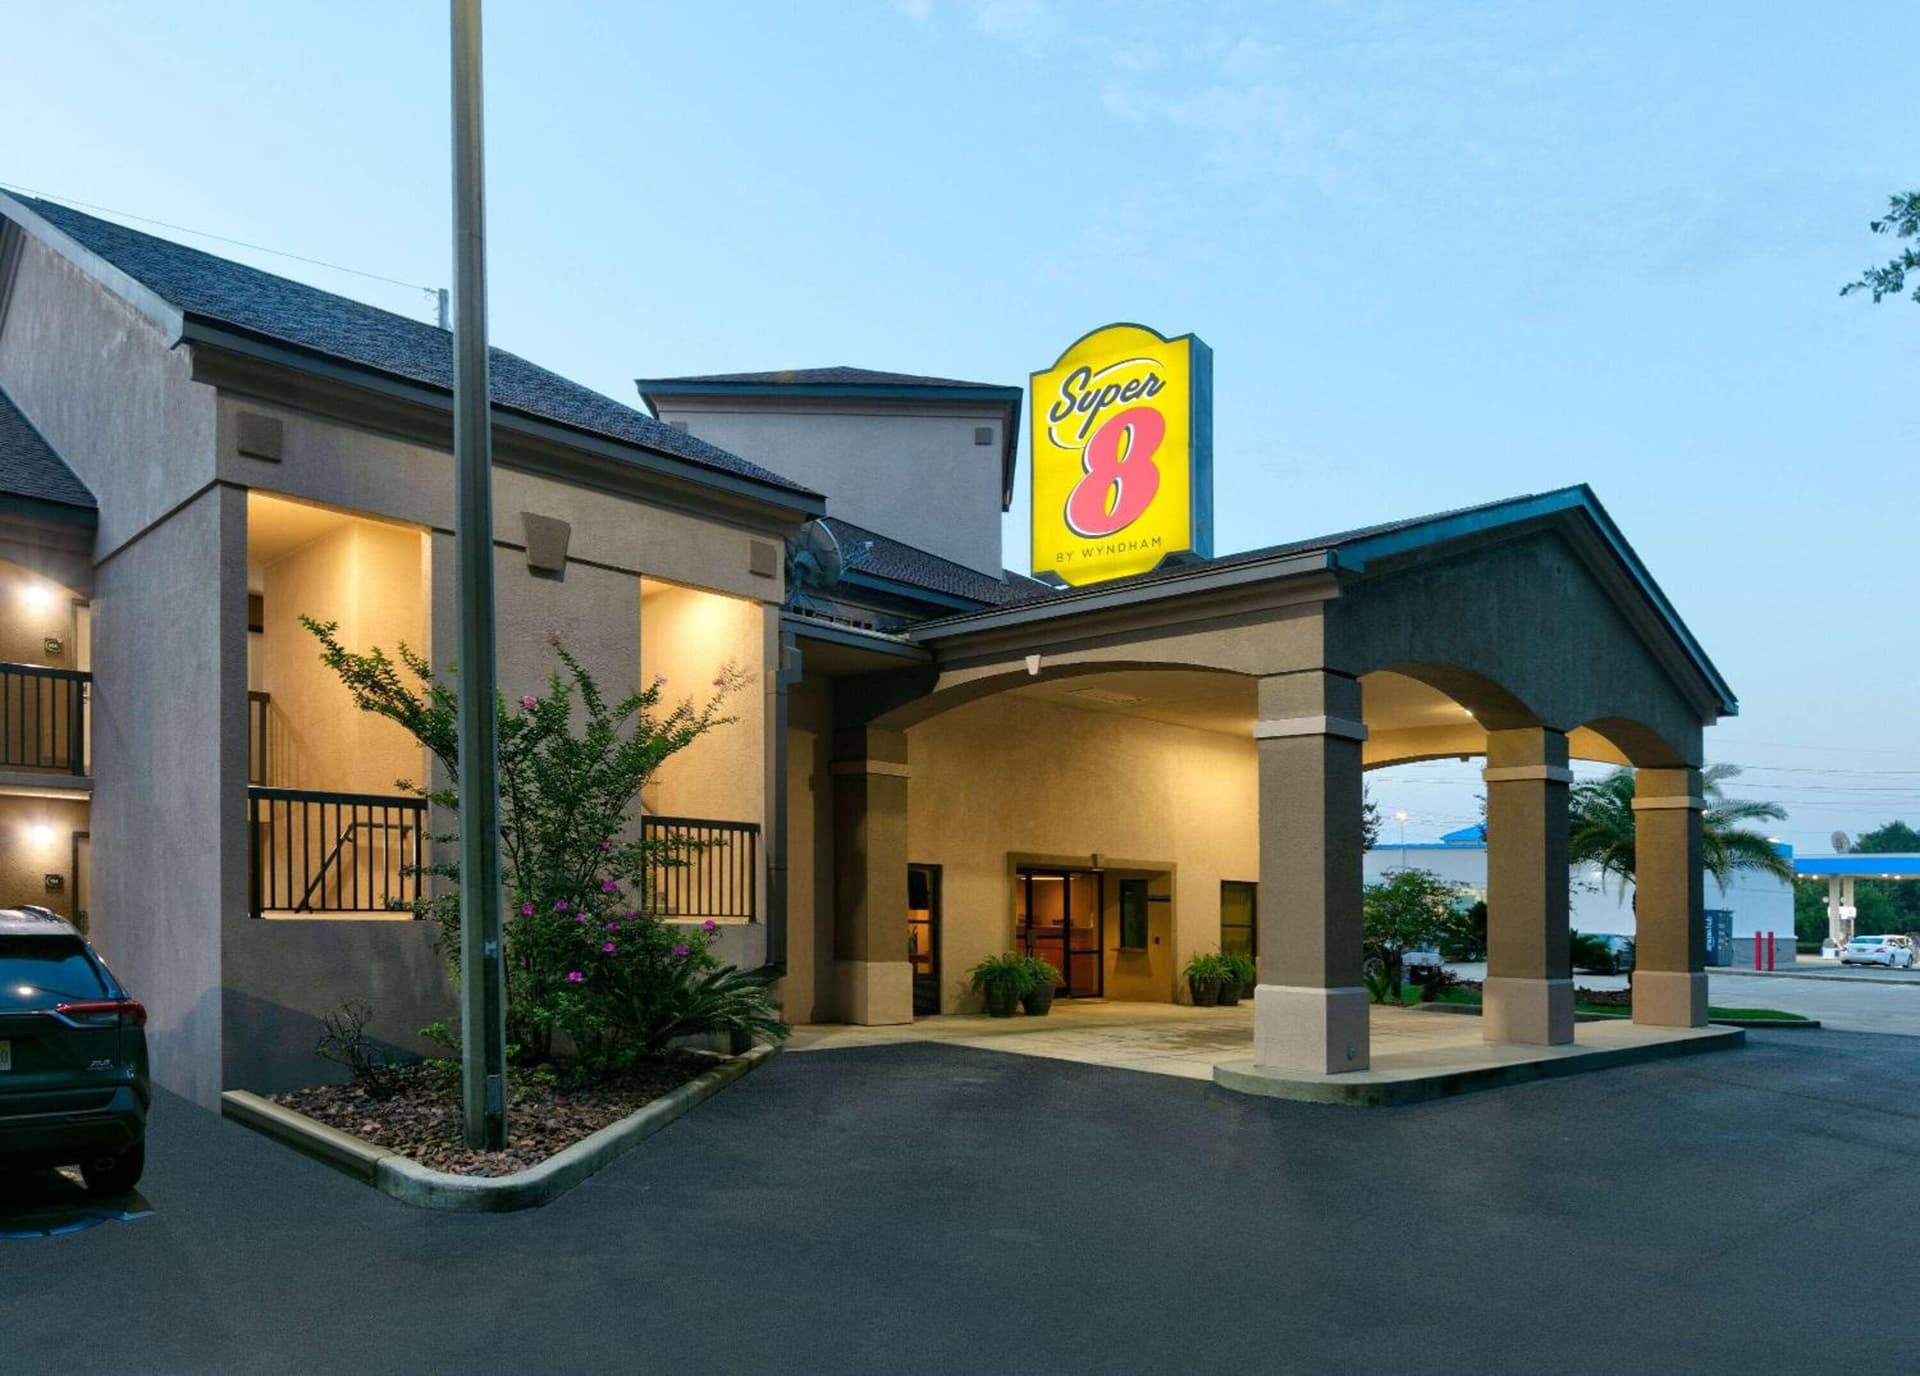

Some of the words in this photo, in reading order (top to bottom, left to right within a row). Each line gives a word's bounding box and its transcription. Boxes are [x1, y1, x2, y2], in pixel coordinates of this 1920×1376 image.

[1049, 365, 1166, 441] Super
[1063, 406, 1166, 539] 8
[1056, 551, 1074, 563] BY
[1081, 536, 1163, 558] WYNDHAM
